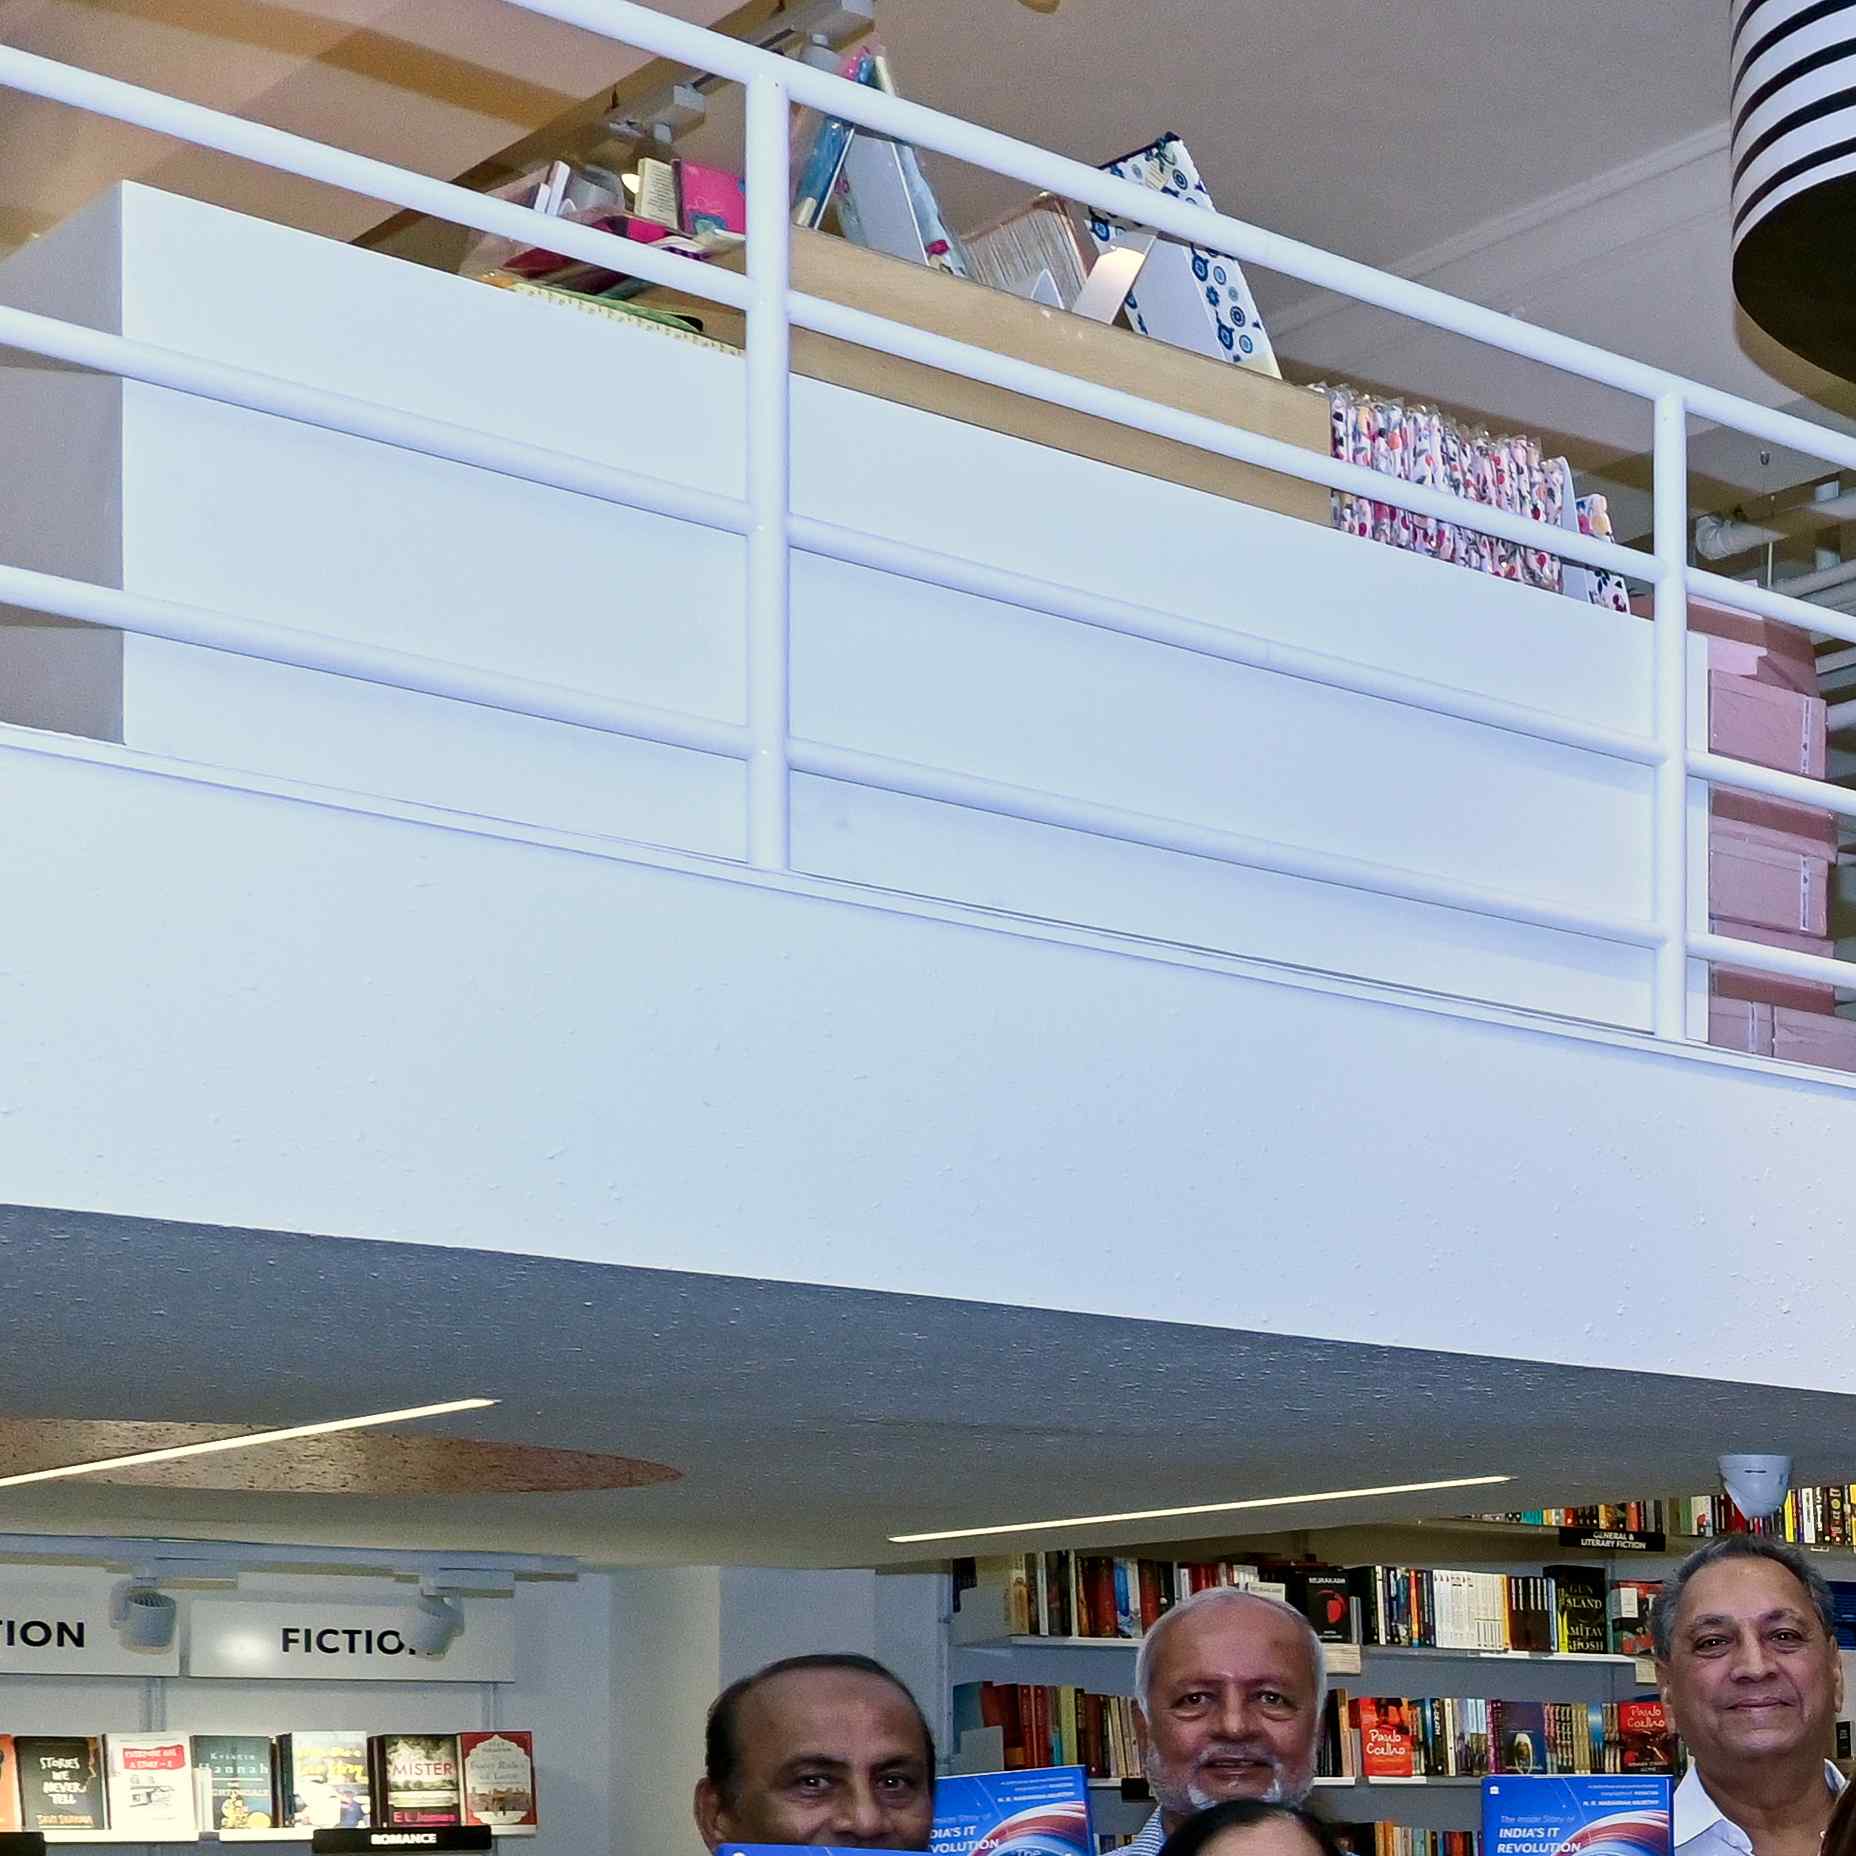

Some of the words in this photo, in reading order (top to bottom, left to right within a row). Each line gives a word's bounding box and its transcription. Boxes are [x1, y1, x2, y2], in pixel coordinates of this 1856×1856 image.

[1580, 1538, 1615, 1548] LITERARY
[1616, 1540, 1647, 1549] FICTION
[0, 1619, 85, 1648] ION
[281, 1628, 440, 1656] FICTIO
[1369, 1728, 1402, 1744] Paulo
[1366, 1740, 1407, 1757] Coelho
[391, 1762, 453, 1777] MISTER
[370, 1833, 438, 1846] ROMANCE
